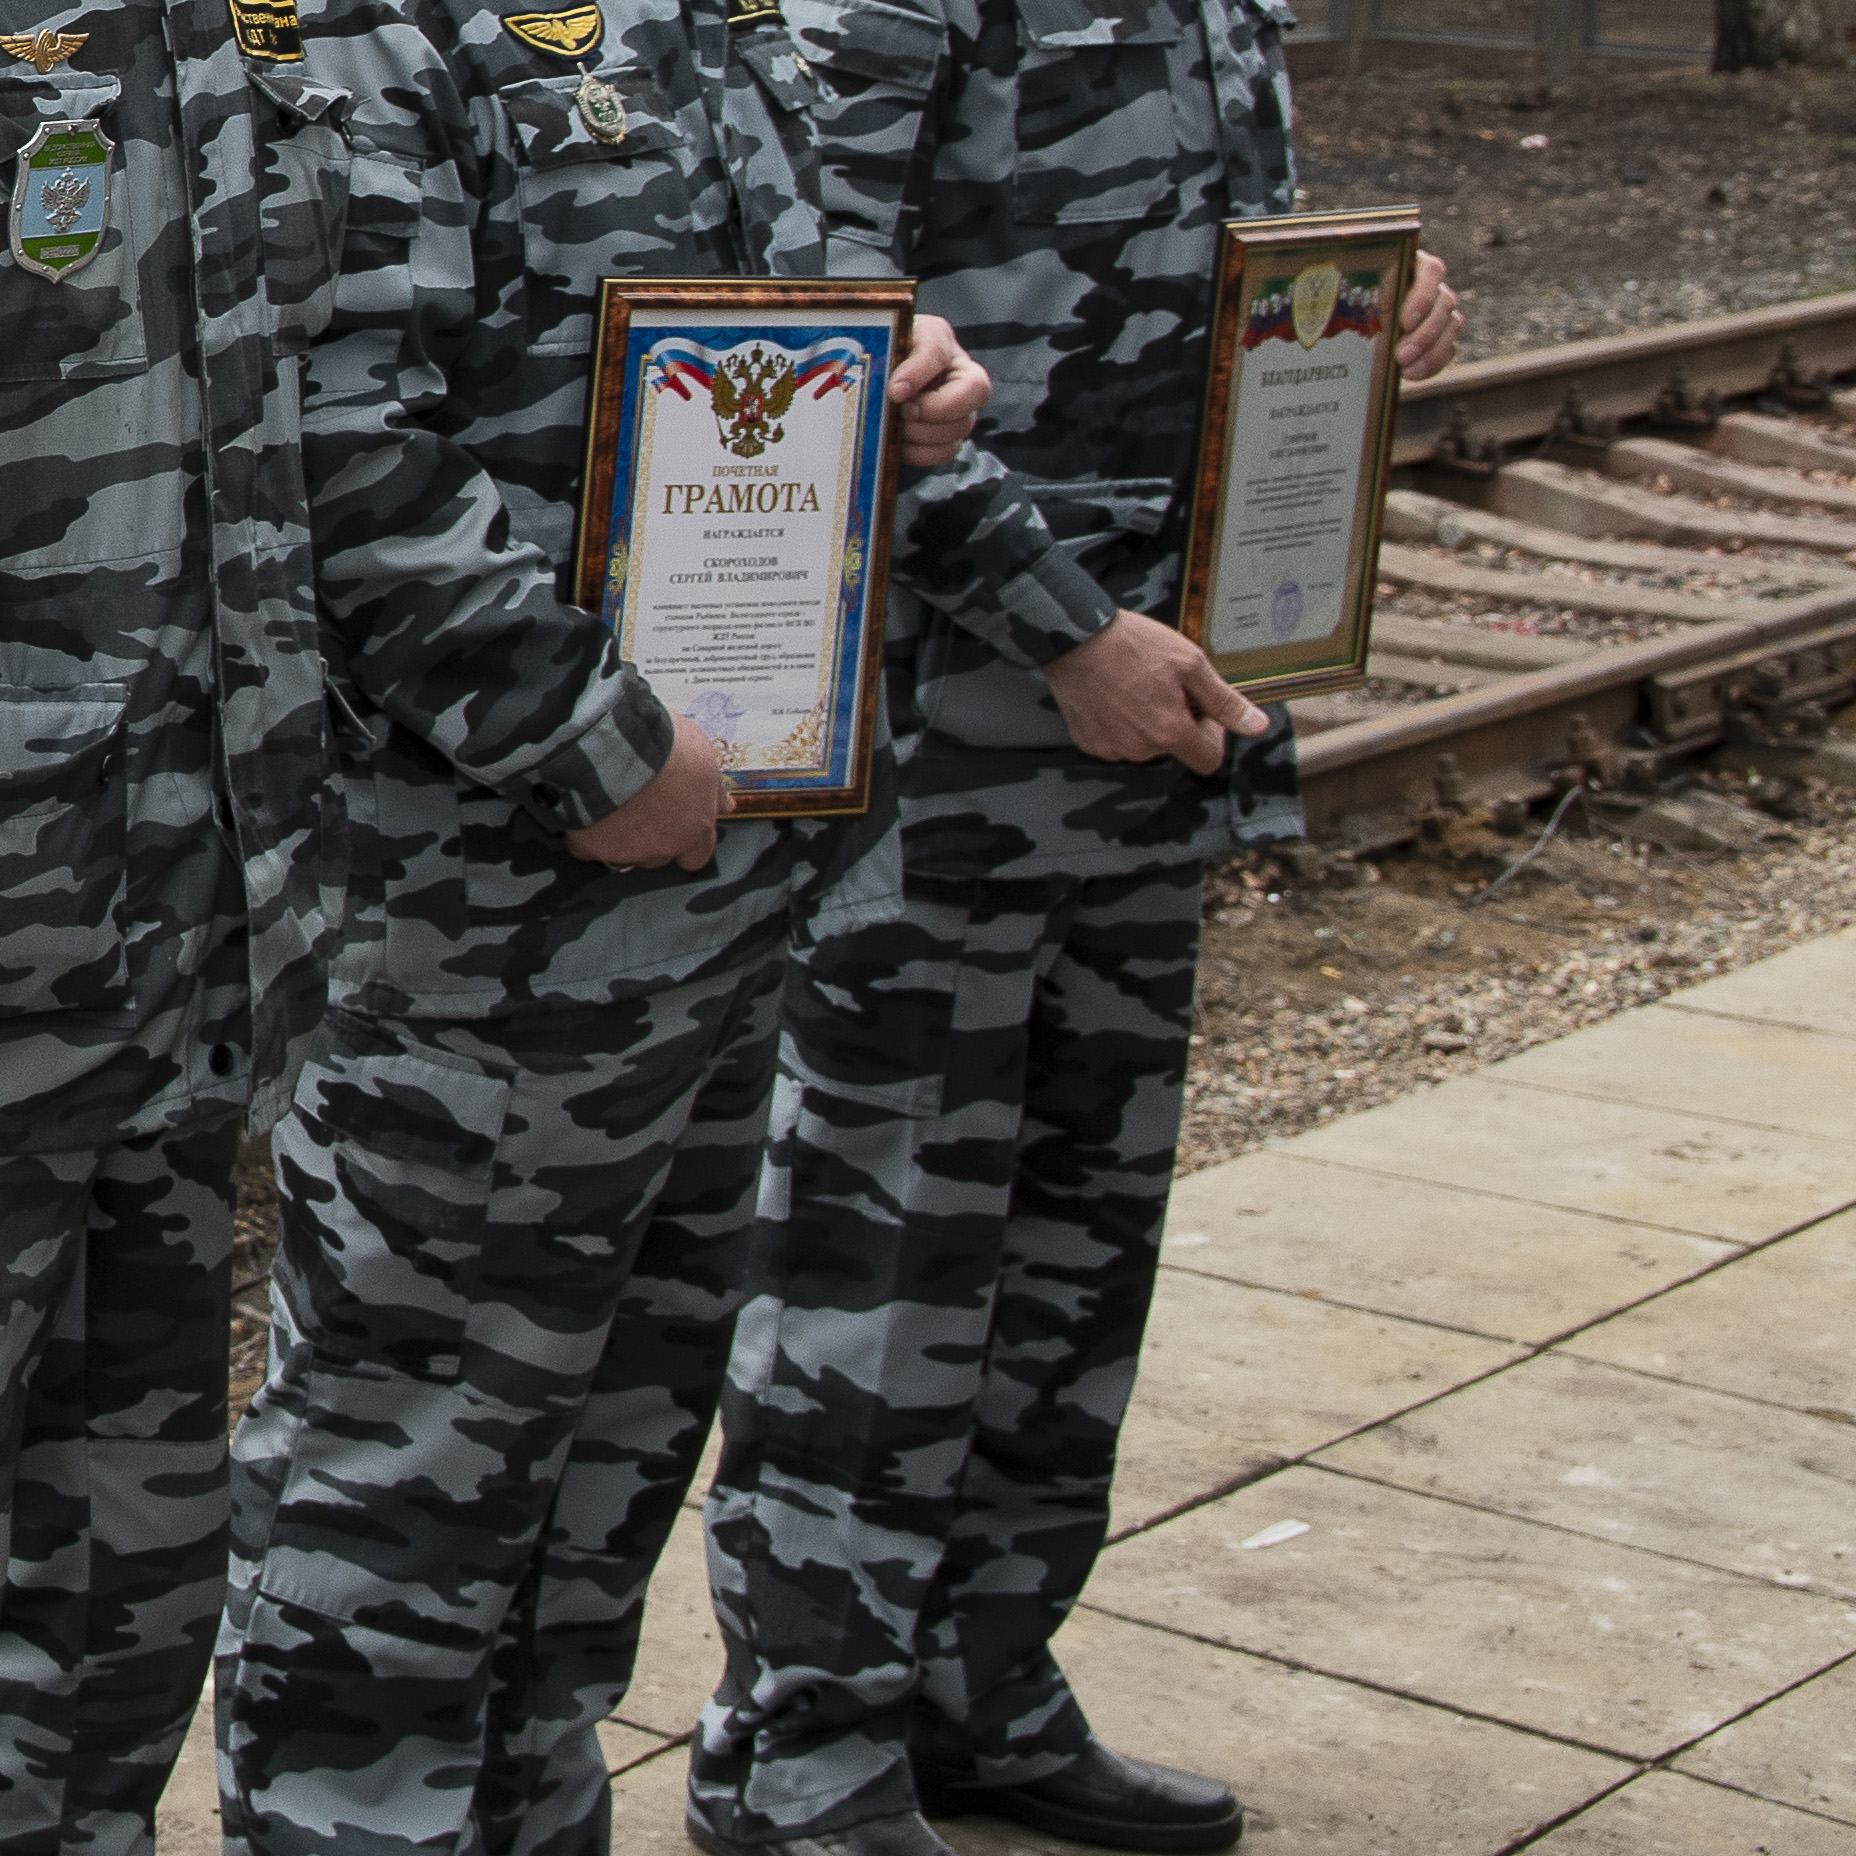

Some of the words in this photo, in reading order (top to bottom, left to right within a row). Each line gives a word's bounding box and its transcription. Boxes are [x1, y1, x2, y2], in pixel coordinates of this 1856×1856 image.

[711, 464, 779, 478] ПОЧЕТНАЯ
[661, 482, 822, 515] ГРАМОТА
[702, 527, 785, 541] НАГРАЖДАЕТСЯ
[669, 570, 714, 585] СЕРГЕЙ
